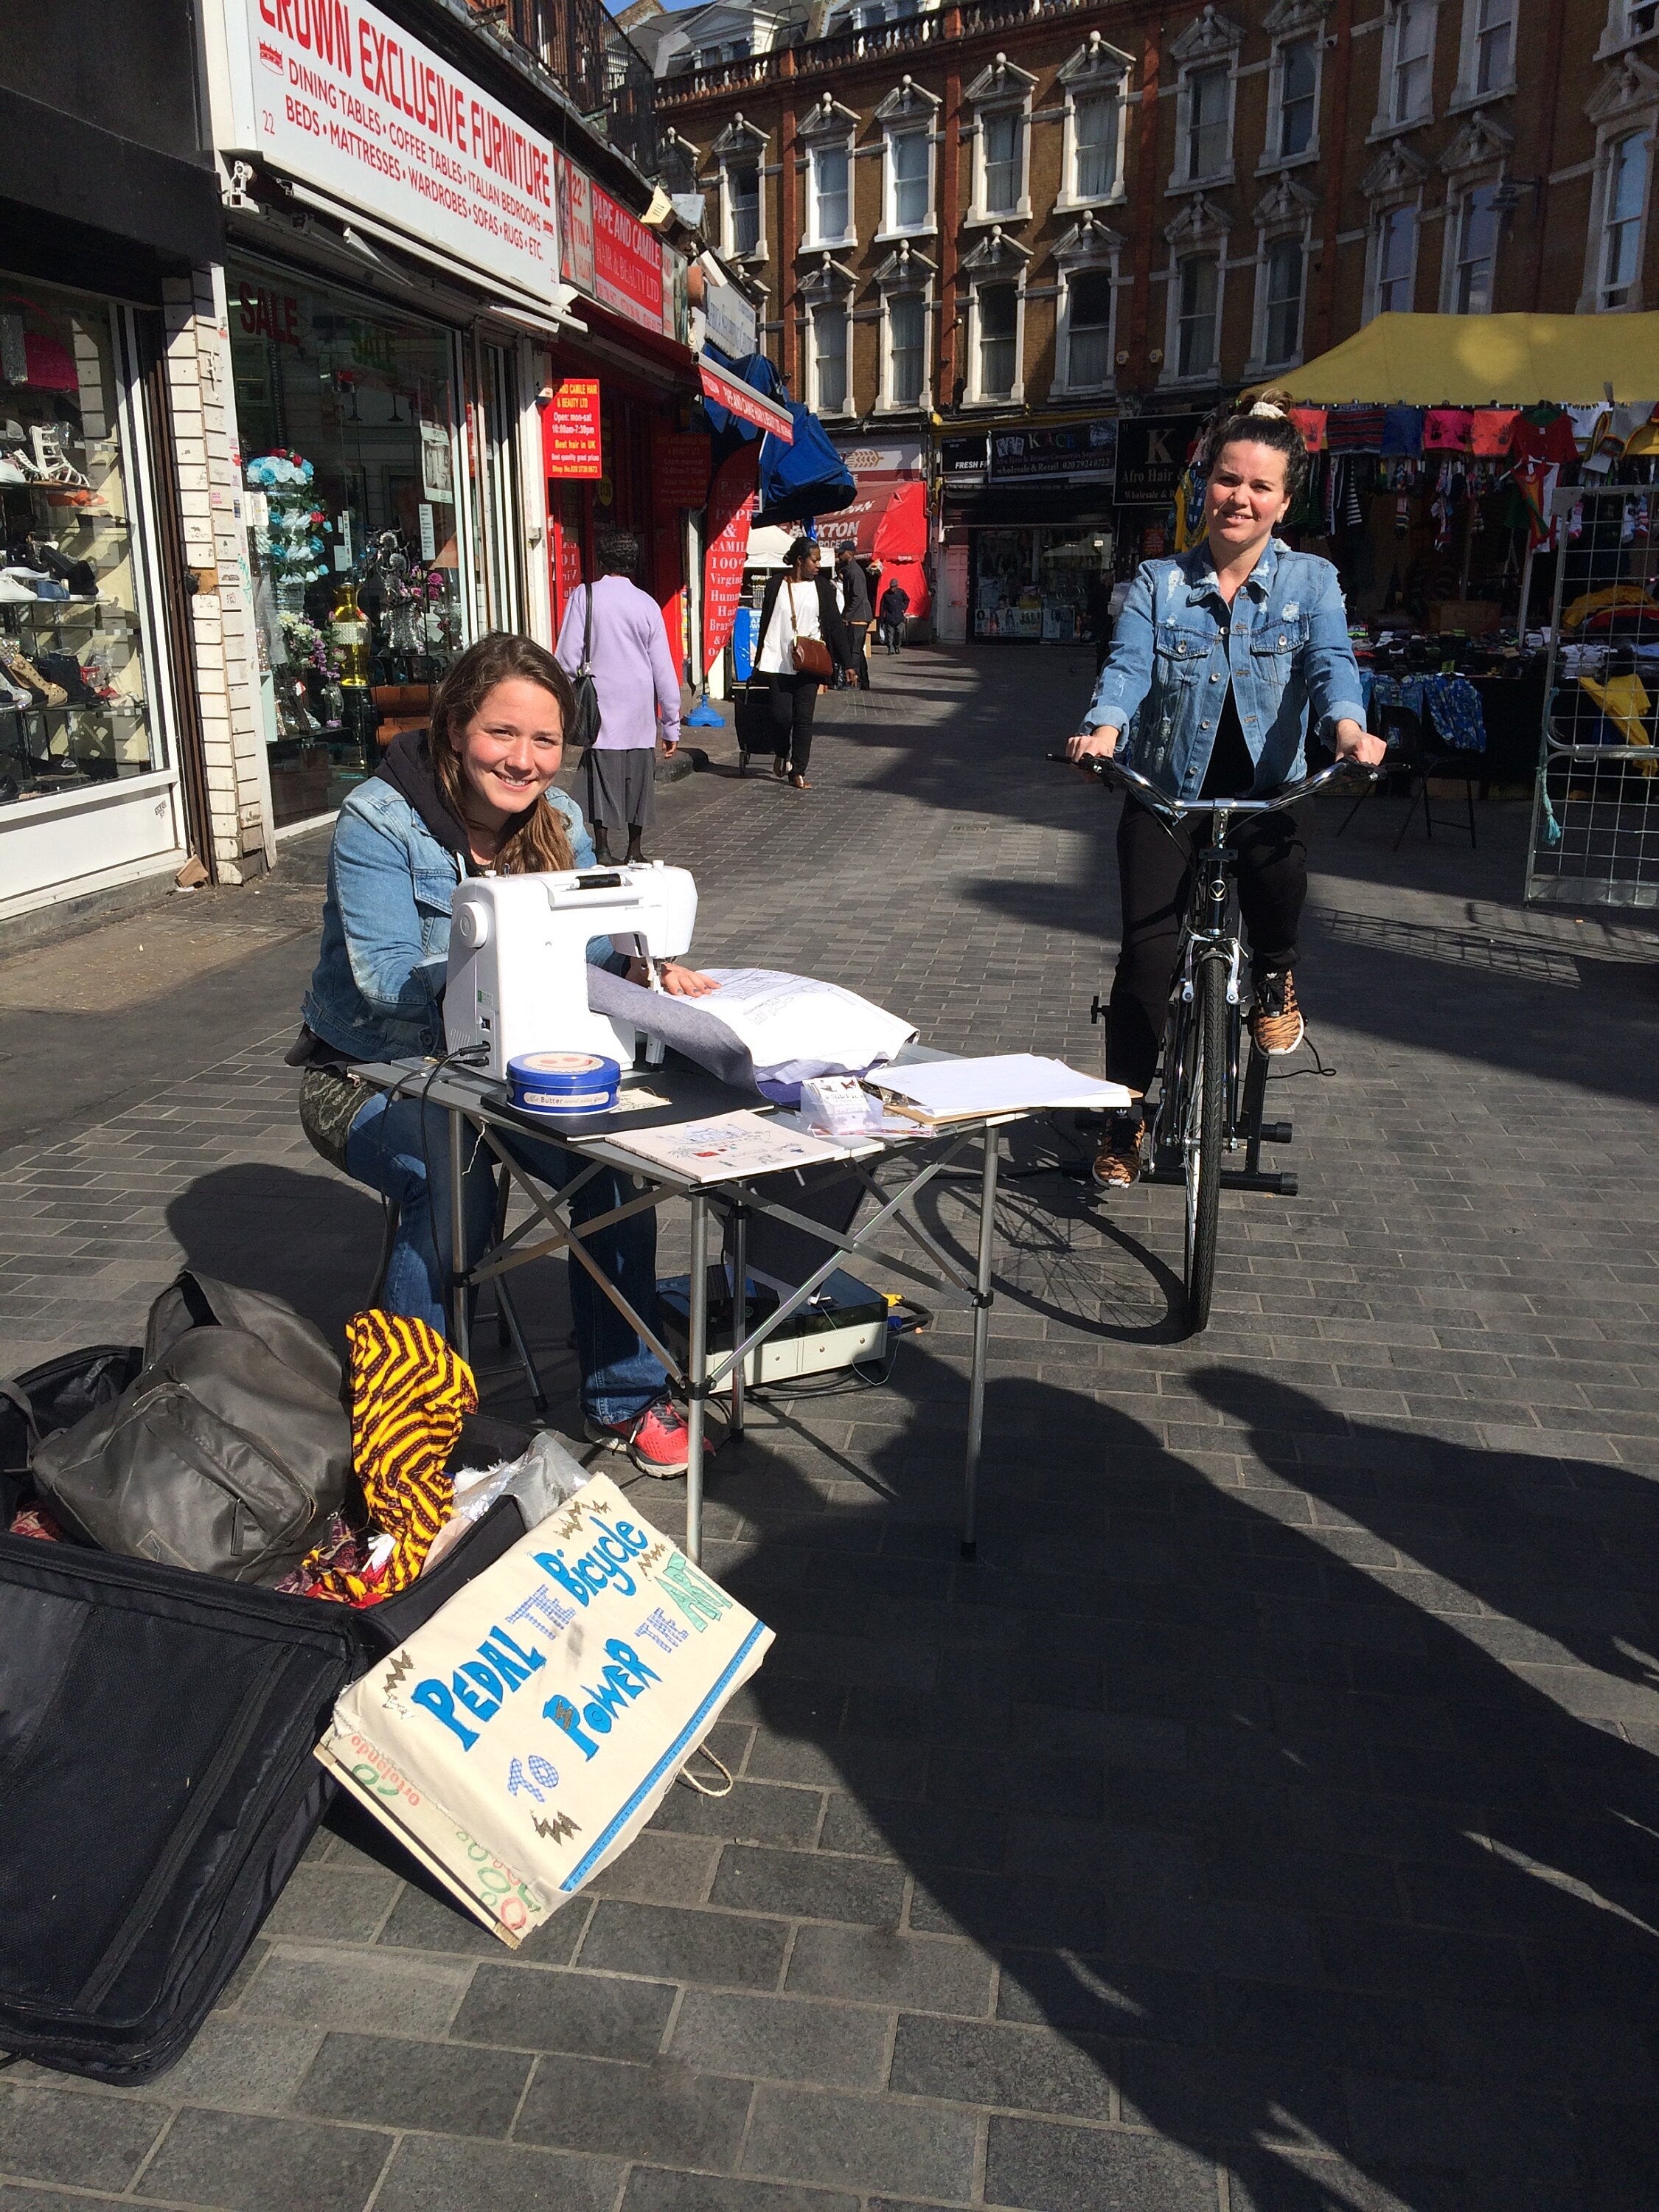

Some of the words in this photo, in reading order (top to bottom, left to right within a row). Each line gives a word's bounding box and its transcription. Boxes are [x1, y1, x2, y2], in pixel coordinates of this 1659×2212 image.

[262, 110, 275, 135] 22
[358, 17, 467, 153] EXCLUSIVE
[471, 100, 551, 208] FURNITURE
[285, 94, 319, 136] BEDS
[330, 120, 400, 181] MATTRESSES
[408, 166, 467, 218] WARDROBES
[473, 204, 498, 236] SOFAS
[504, 221, 524, 249] RUGS
[288, 57, 337, 109] DINING
[338, 88, 381, 136] TABLES
[389, 122, 427, 164] COFFEE
[429, 145, 462, 185] TABLES
[468, 170, 500, 207] ITALIAN
[501, 192, 540, 232] BEDROOMS
[614, 212, 632, 248] AND
[633, 223, 661, 271] CAMILE
[239, 282, 300, 347] SALE
[646, 275, 660, 304] LTD
[554, 439, 567, 449] Best
[587, 440, 597, 450] UK
[955, 461, 978, 470] FRESH
[723, 523, 737, 538] &
[653, 1551, 734, 1633] ART
[634, 1607, 689, 1654] THE
[409, 1625, 547, 1752] PEDAL
[505, 1584, 577, 1641] THE
[542, 1638, 664, 1762] POWER
[507, 1754, 560, 1804] TO
